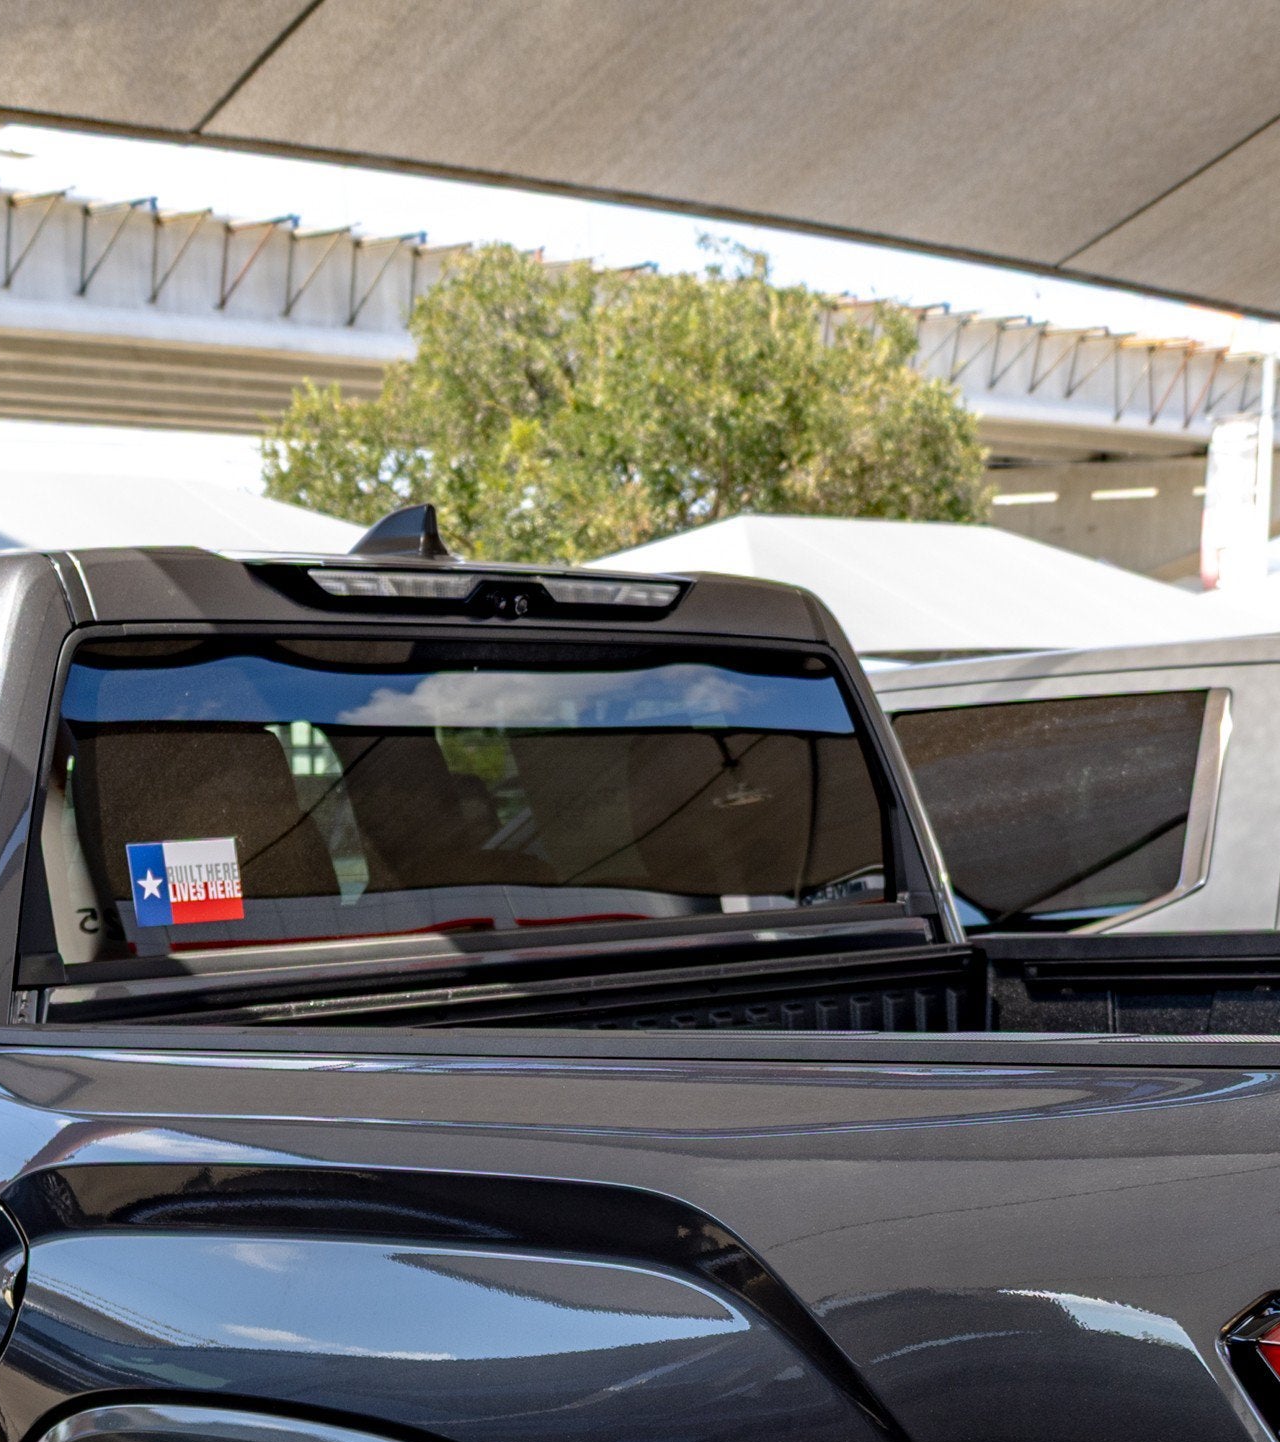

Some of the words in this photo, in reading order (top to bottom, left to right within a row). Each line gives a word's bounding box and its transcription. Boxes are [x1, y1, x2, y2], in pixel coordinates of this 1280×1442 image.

[166, 864, 202, 884] BUILT
[206, 862, 239, 881] HERE
[169, 881, 206, 903] LIVES
[208, 880, 242, 900] HERE
